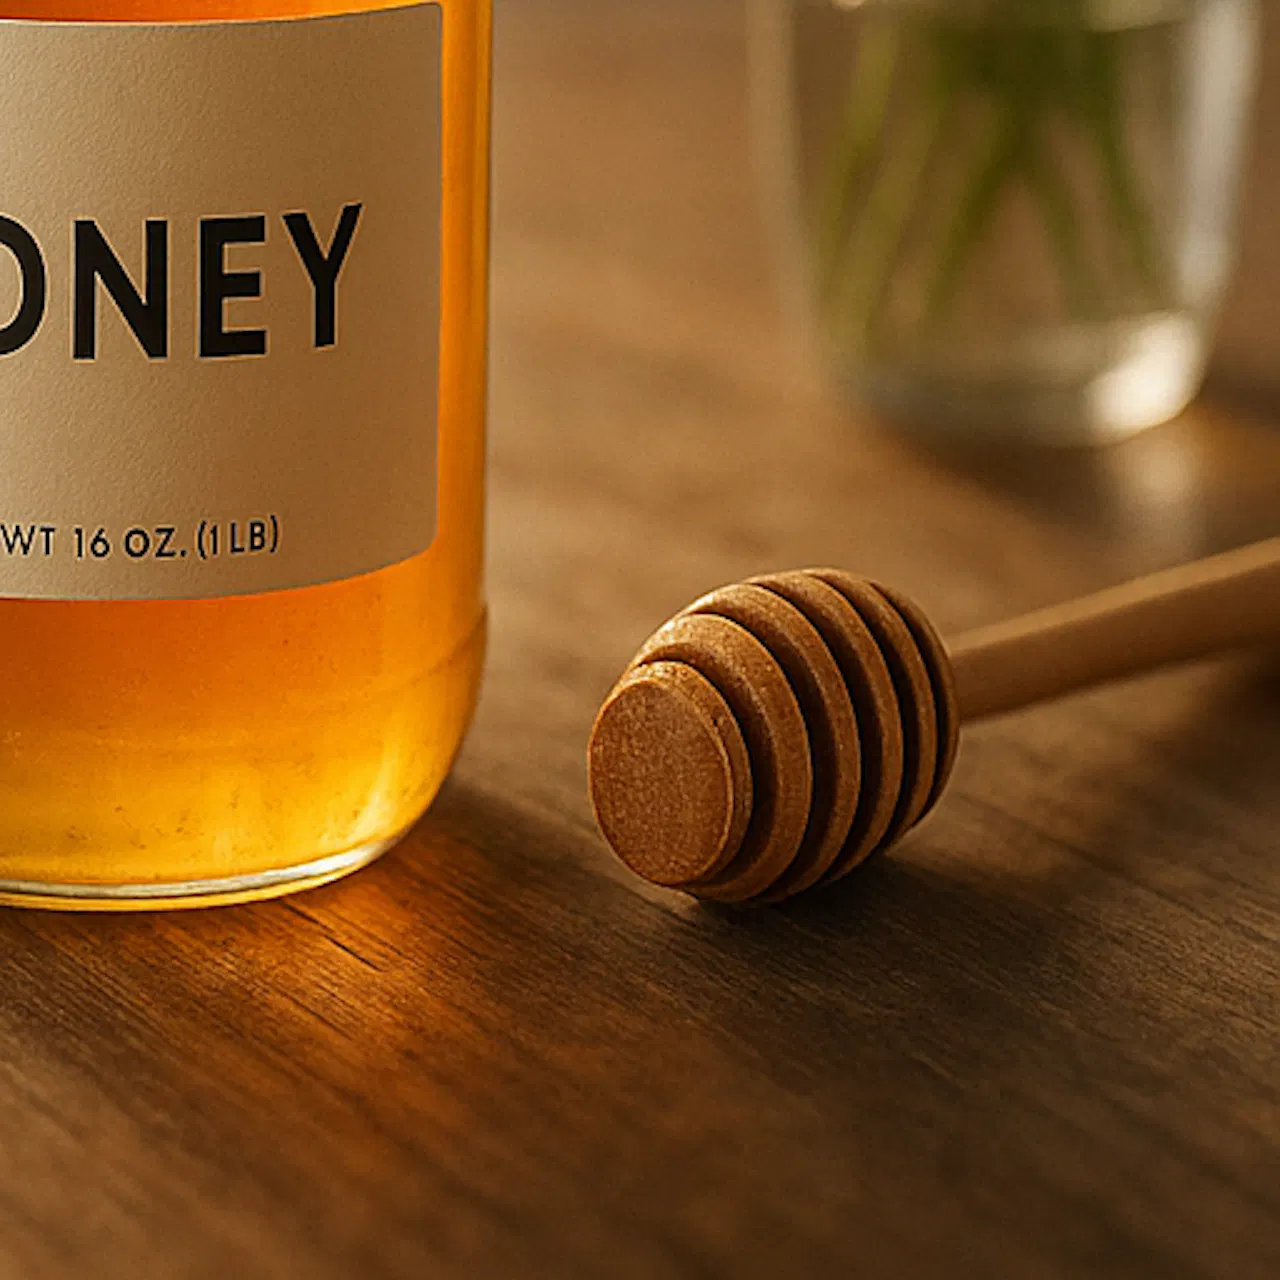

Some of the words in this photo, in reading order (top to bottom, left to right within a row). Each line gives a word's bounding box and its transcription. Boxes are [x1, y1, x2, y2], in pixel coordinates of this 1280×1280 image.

[0, 523, 57, 556] WT
[74, 527, 111, 559] 16
[123, 526, 188, 559] OZ.
[197, 519, 219, 561] (1
[229, 513, 281, 555] LB)
